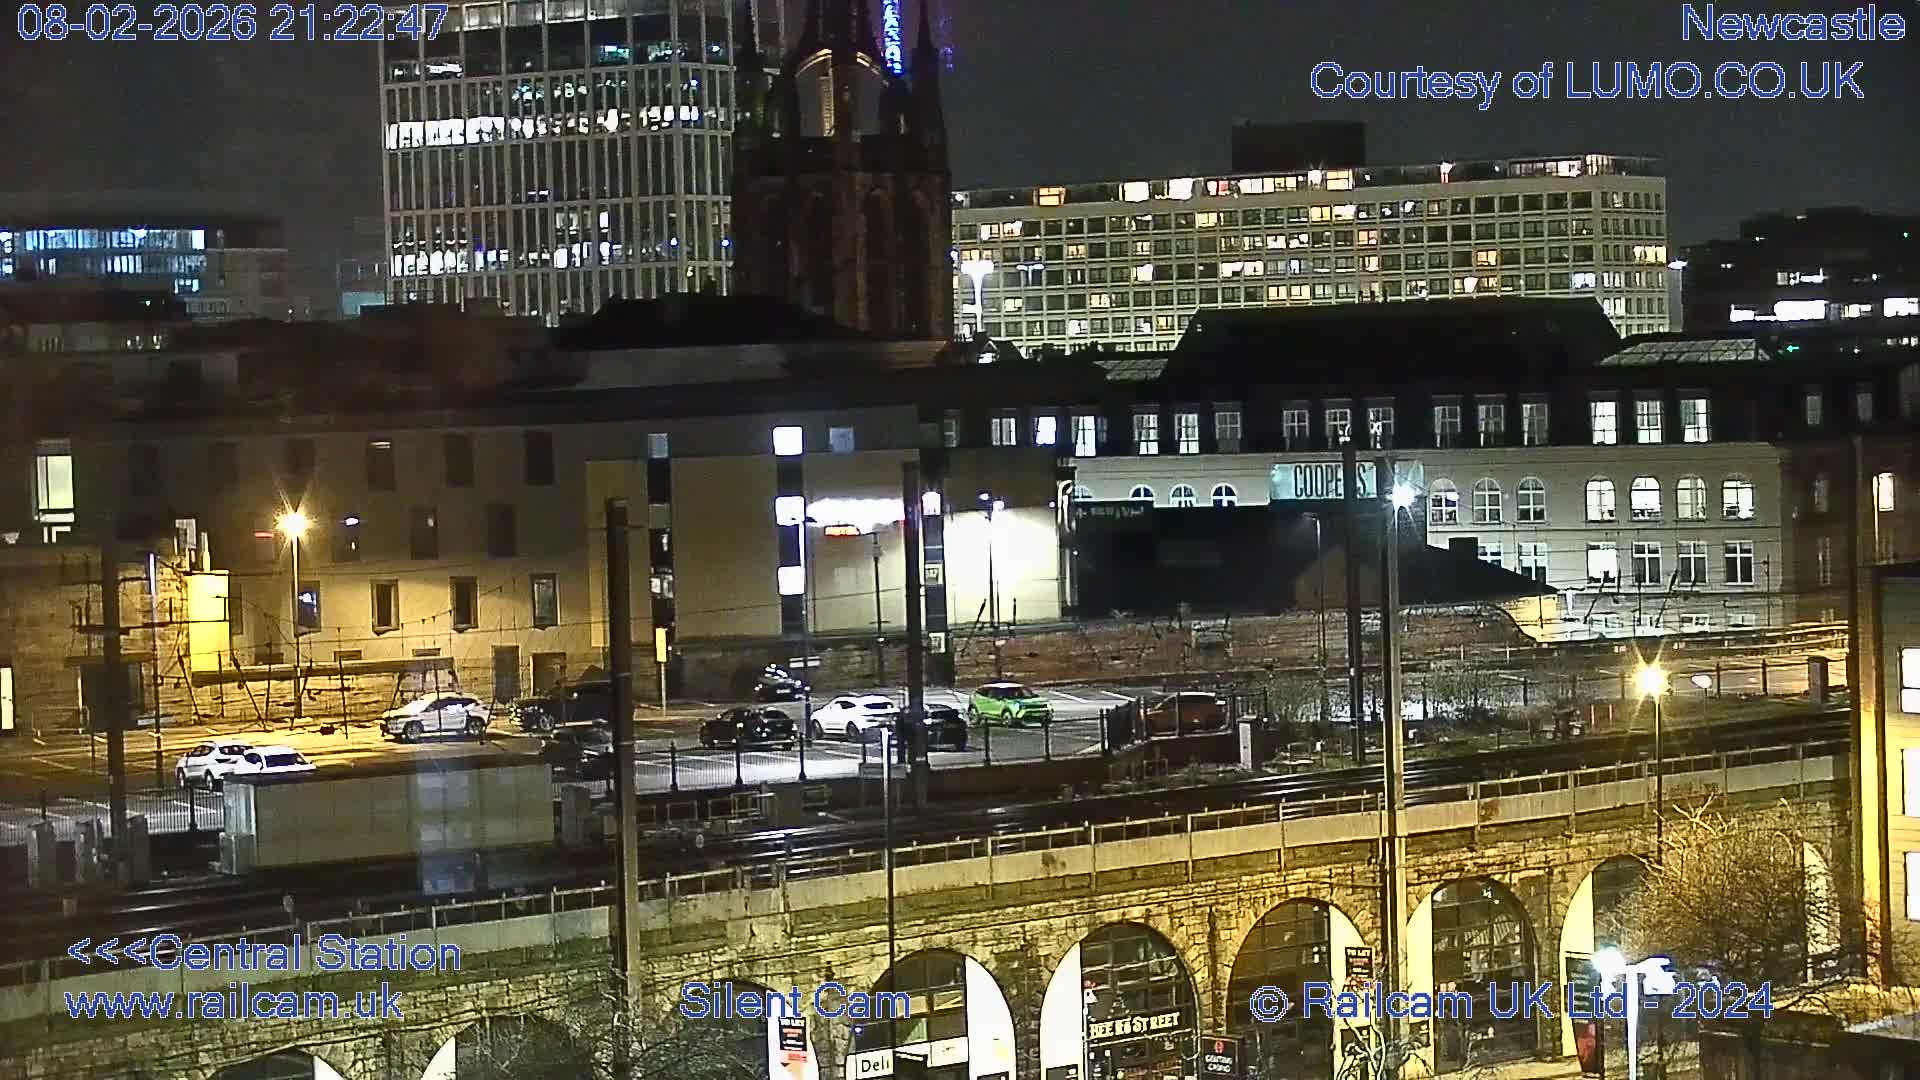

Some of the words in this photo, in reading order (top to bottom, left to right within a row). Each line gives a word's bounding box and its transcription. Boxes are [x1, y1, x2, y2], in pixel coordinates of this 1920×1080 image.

[1294, 464, 1367, 498] COOPES
[1132, 1012, 1181, 1033] STREET
[861, 1055, 890, 1073] Deli
